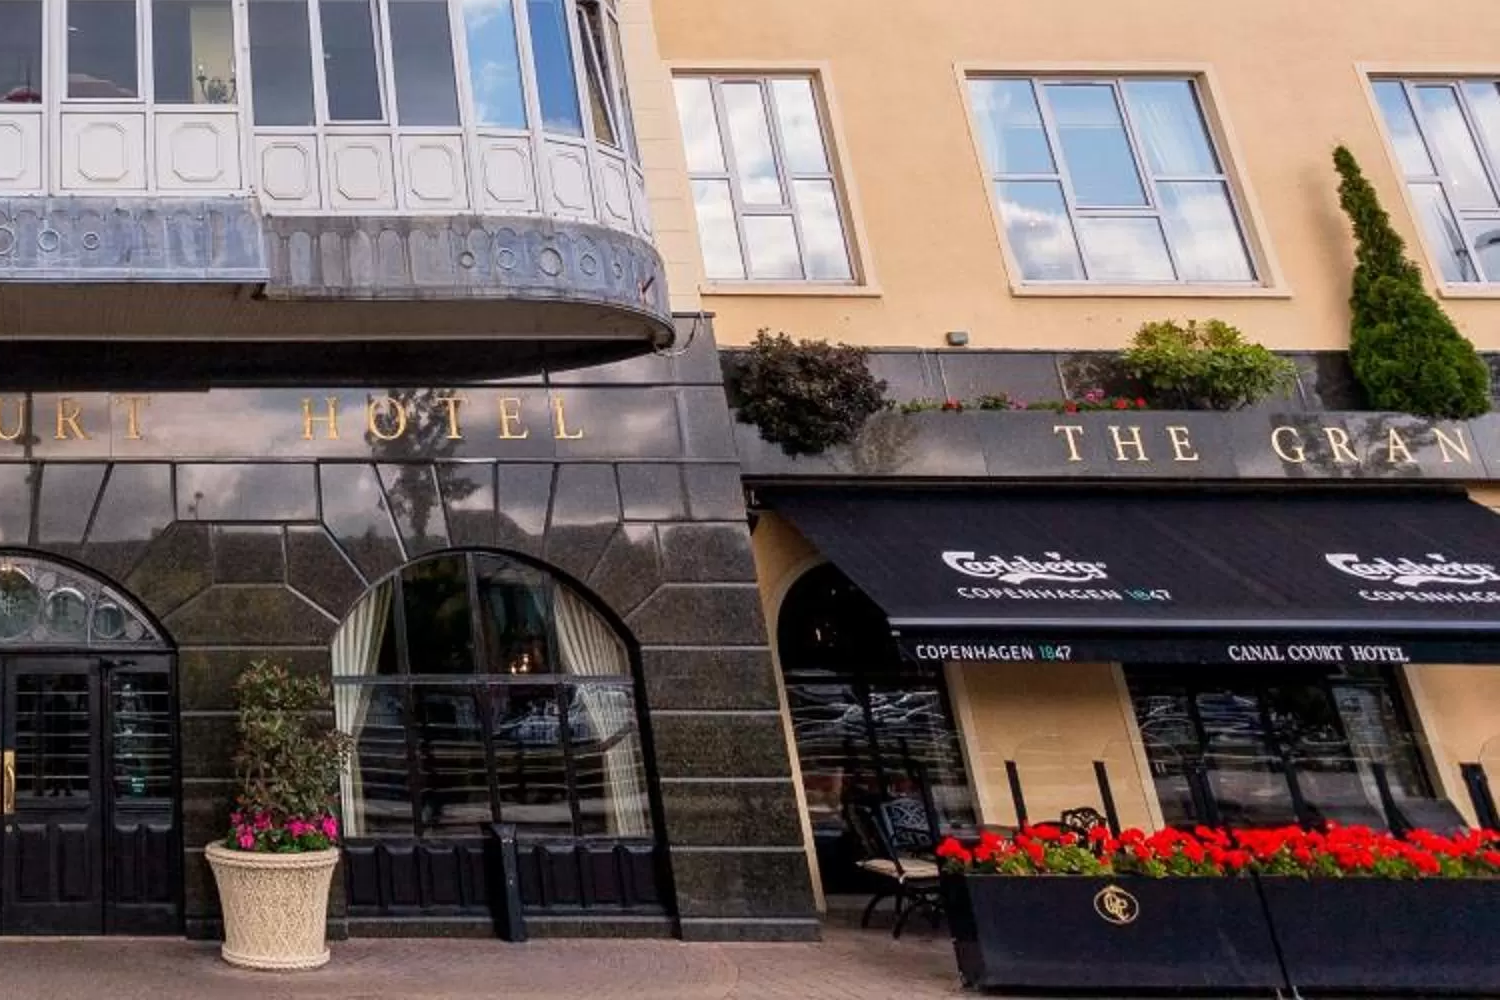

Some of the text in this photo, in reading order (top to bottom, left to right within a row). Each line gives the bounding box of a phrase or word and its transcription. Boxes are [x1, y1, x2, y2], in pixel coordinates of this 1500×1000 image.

[301, 395, 585, 440] HOTEL
[1053, 425, 1500, 464] THE GRAN
[941, 551, 1108, 585] Carlsberg
[957, 586, 1172, 602] COPENHAGEN 1847
[916, 645, 1071, 661] COPENHAGEN 1847
[1228, 645, 1409, 662] CANAL COURT HOTEL
